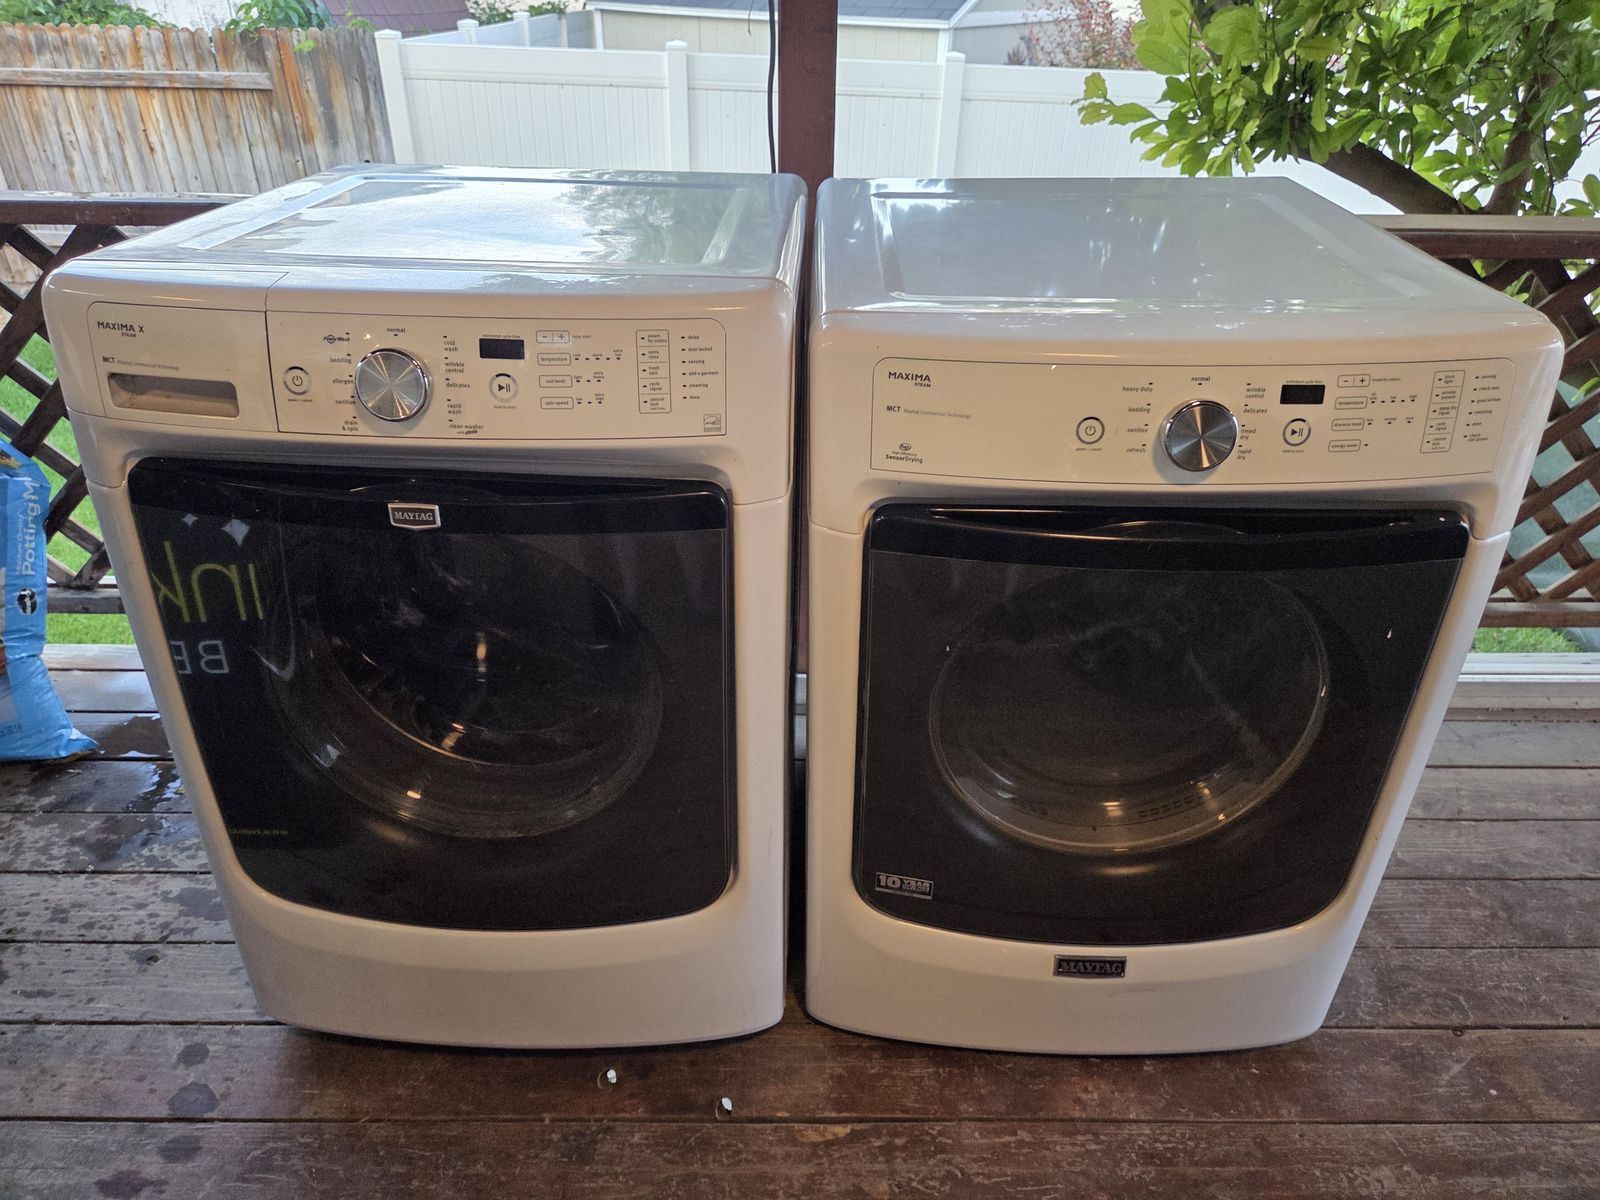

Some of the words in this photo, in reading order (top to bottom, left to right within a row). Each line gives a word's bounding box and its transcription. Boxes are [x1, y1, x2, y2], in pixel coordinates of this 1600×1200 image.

[97, 321, 136, 332] MAXIMA
[138, 325, 145, 333] X
[102, 356, 115, 364] MCT
[888, 372, 932, 382] MAXIMA
[886, 404, 901, 413] MCT
[885, 454, 924, 464] SensorDrying
[394, 512, 433, 520] MAYTAG
[879, 875, 900, 888] 10
[1061, 961, 1122, 974] MAYTAG
